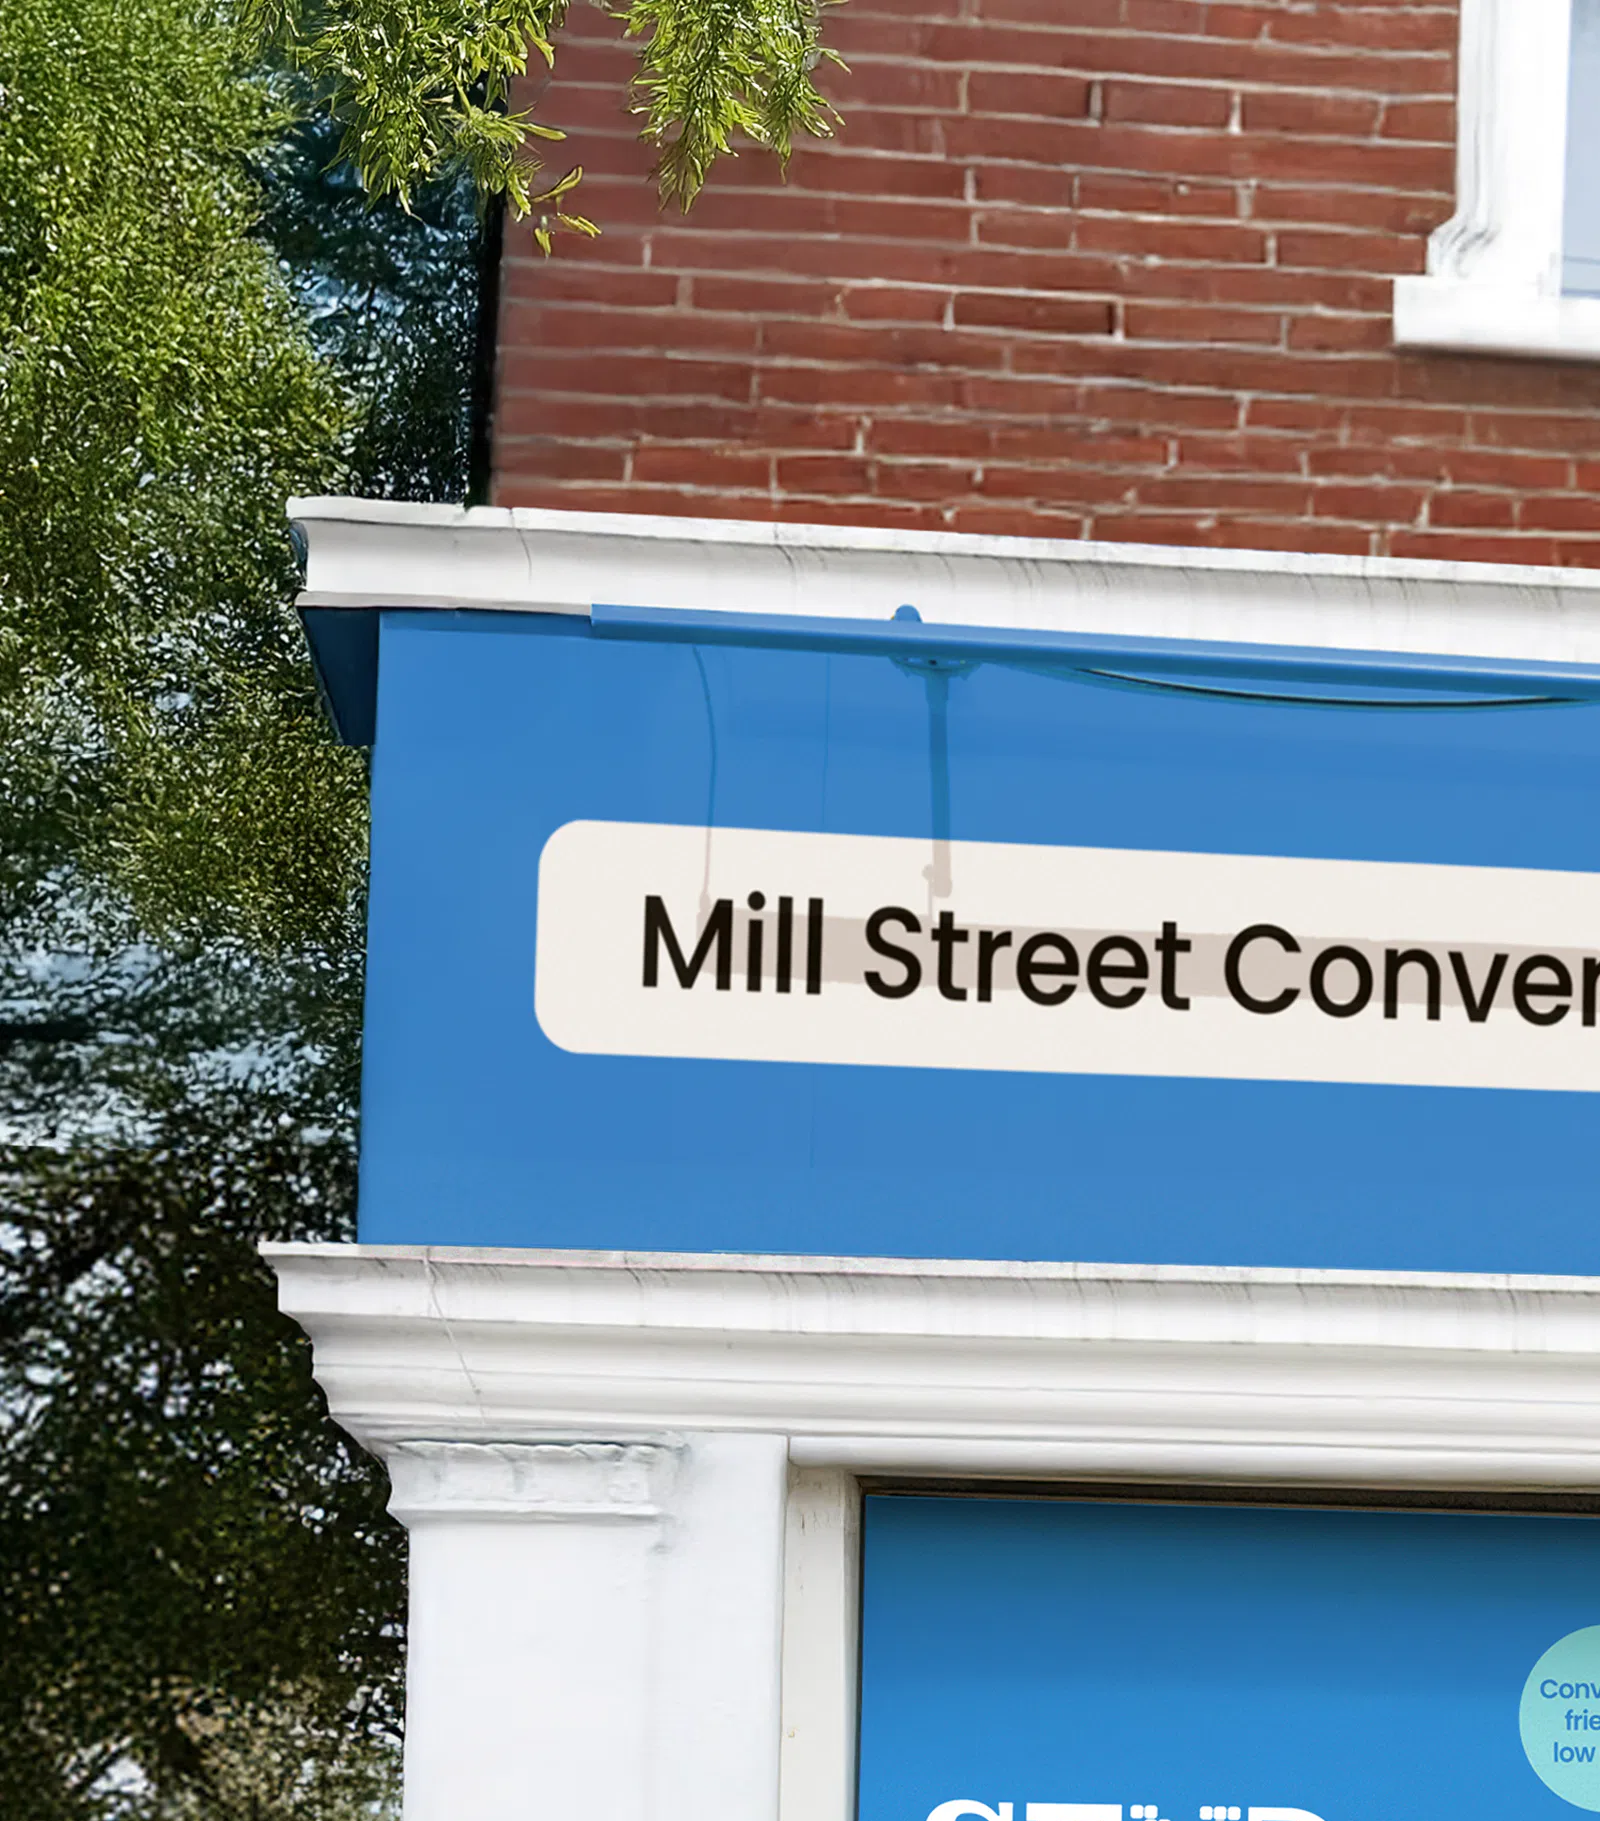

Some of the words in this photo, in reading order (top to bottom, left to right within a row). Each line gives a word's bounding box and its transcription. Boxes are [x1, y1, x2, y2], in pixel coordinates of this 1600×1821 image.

[641, 895, 824, 995] Mill
[864, 905, 1193, 1011] Street
[1553, 1742, 1597, 1763] low
